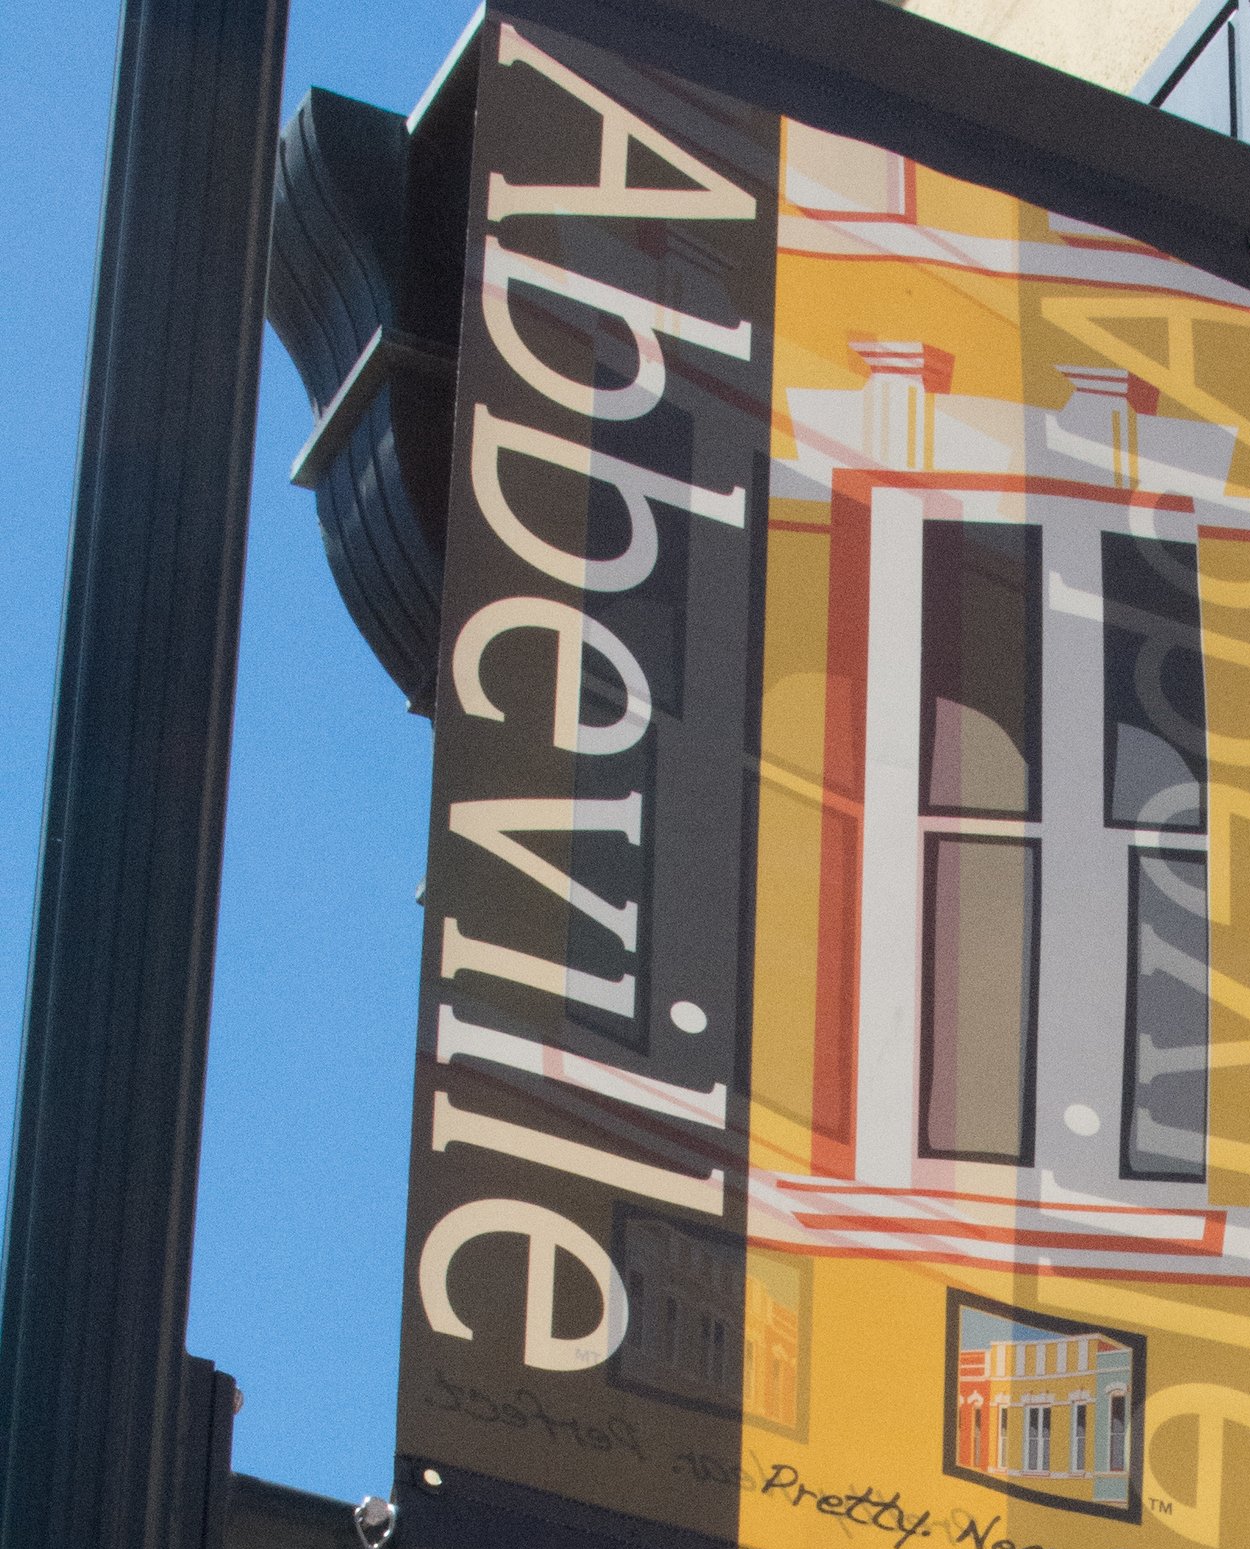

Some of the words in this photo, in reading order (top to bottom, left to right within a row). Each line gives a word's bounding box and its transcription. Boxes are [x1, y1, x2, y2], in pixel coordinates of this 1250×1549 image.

[418, 23, 757, 1372] Abbeville
[761, 1463, 931, 1549] Pretty.
[1148, 1497, 1173, 1516] TM
